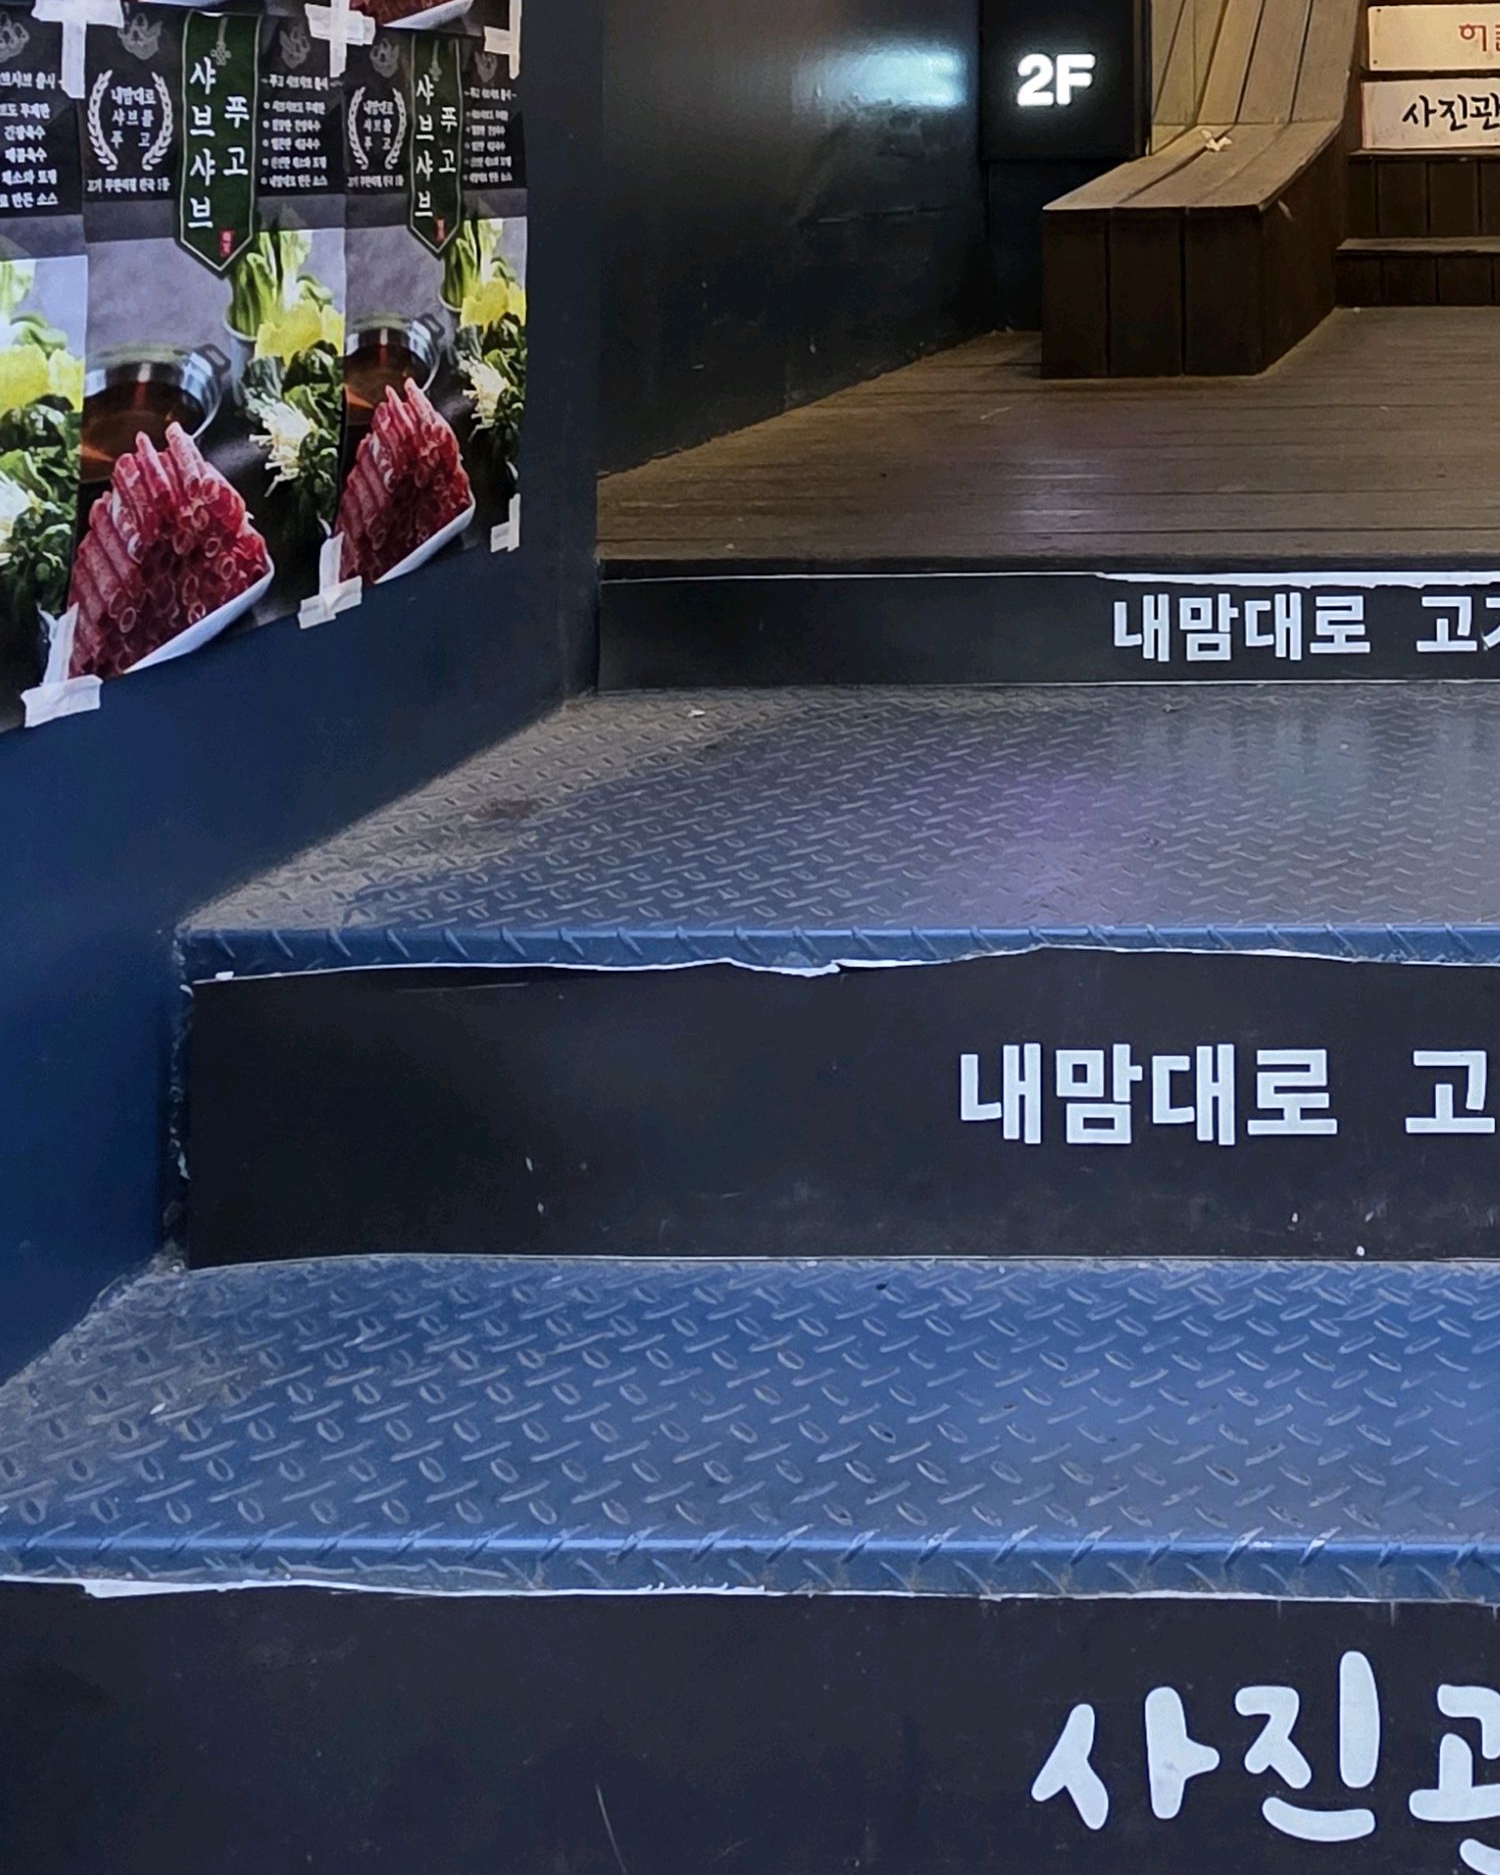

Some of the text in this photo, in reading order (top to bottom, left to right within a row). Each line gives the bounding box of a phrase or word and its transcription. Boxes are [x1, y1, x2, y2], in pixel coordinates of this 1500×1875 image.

[110, 86, 157, 105] 내맘대로
[1016, 52, 1097, 109] 2F
[188, 55, 217, 229] 샤브샤브
[222, 95, 251, 178] 푸고
[415, 74, 435, 218] 샤브샤브
[439, 106, 459, 174] 푸고
[1113, 591, 1371, 663] 내맘대로
[960, 1042, 1338, 1147] 내맘대로
